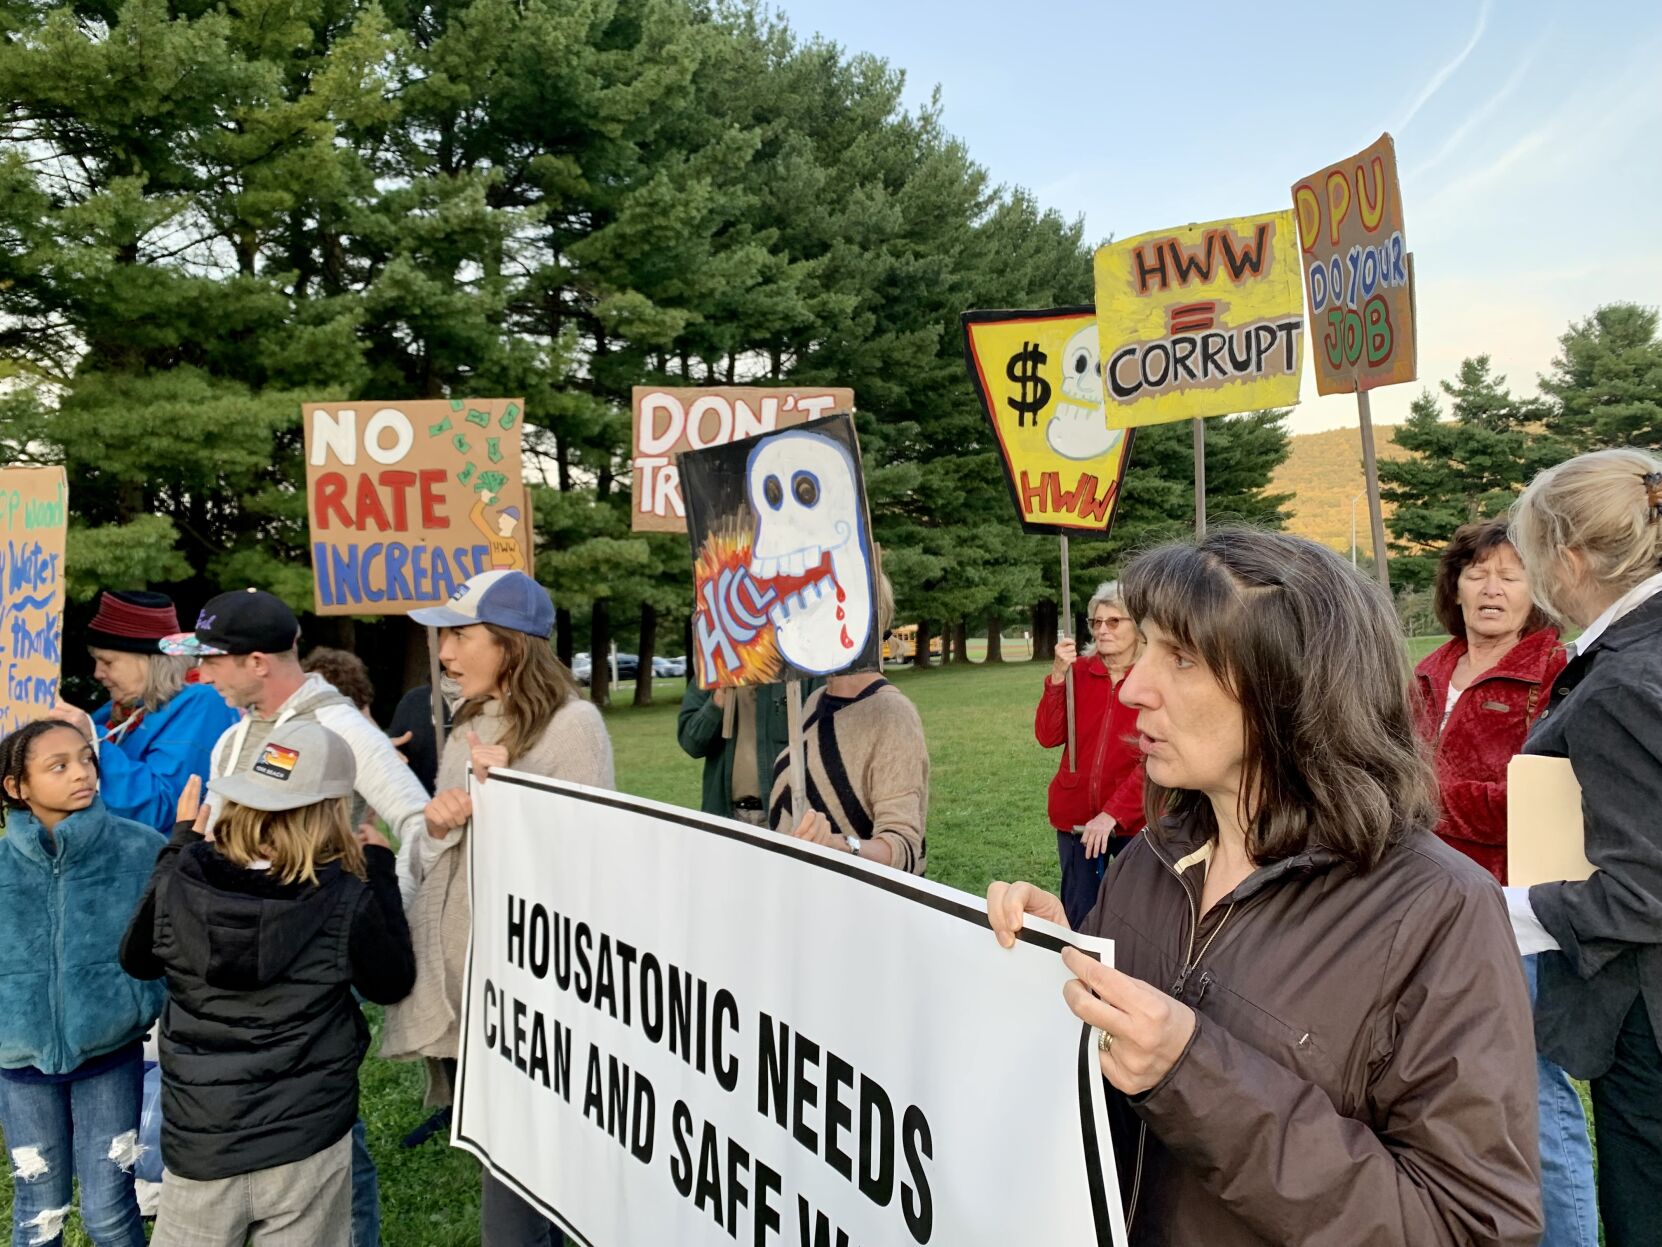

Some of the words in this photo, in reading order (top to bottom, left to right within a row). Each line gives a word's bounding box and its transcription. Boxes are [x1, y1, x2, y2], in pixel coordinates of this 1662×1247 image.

[1295, 155, 1385, 253] DPU
[1135, 224, 1270, 296] HWW
[1309, 253, 1344, 314] DO
[1346, 230, 1408, 311] YOUR
[1106, 317, 1304, 400] CORRUPT
[1324, 294, 1394, 370] JOB
[1006, 341, 1052, 427] $
[310, 408, 414, 466] NO
[314, 468, 450, 533] RATE
[1019, 470, 1118, 522] HWW
[483, 978, 572, 1105] CLEAN
[583, 1042, 656, 1165] AND
[507, 893, 740, 1093] HOUSATONIC
[757, 1011, 934, 1246] NEEDS
